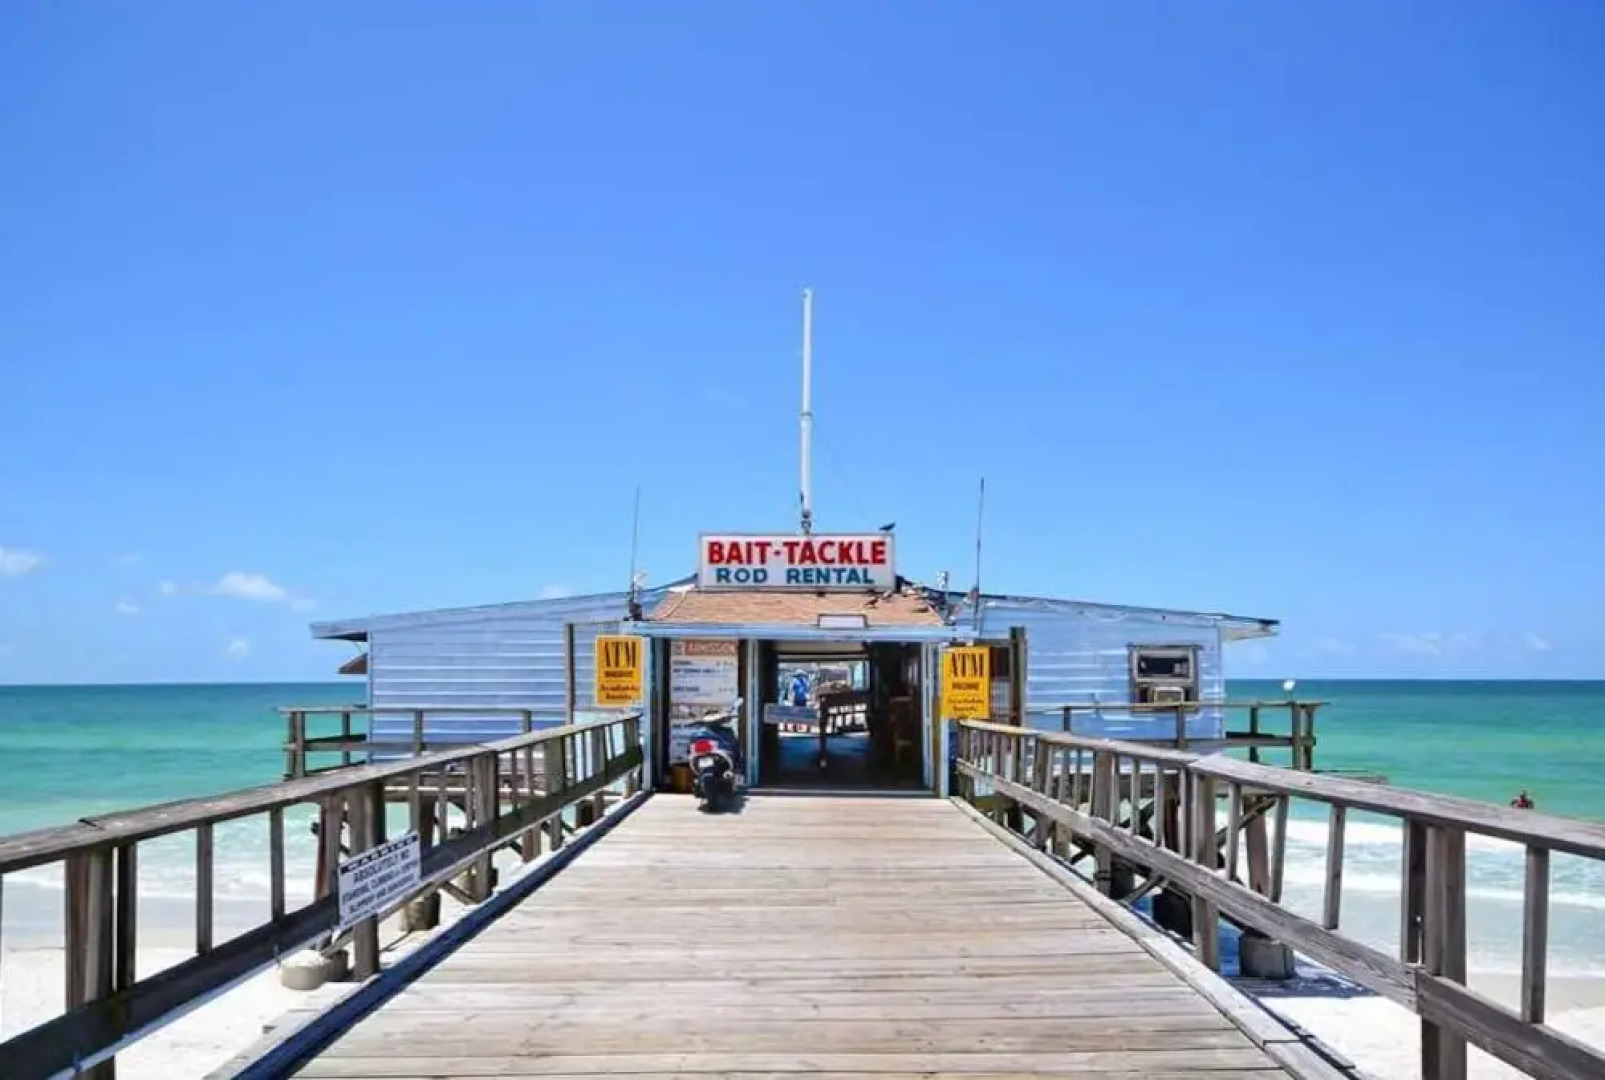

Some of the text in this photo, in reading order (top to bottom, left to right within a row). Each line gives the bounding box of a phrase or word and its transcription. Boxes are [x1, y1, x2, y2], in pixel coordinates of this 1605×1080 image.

[715, 567, 875, 584] ROD RENTAL
[602, 641, 637, 668] ATM
[949, 652, 984, 677] ATM
